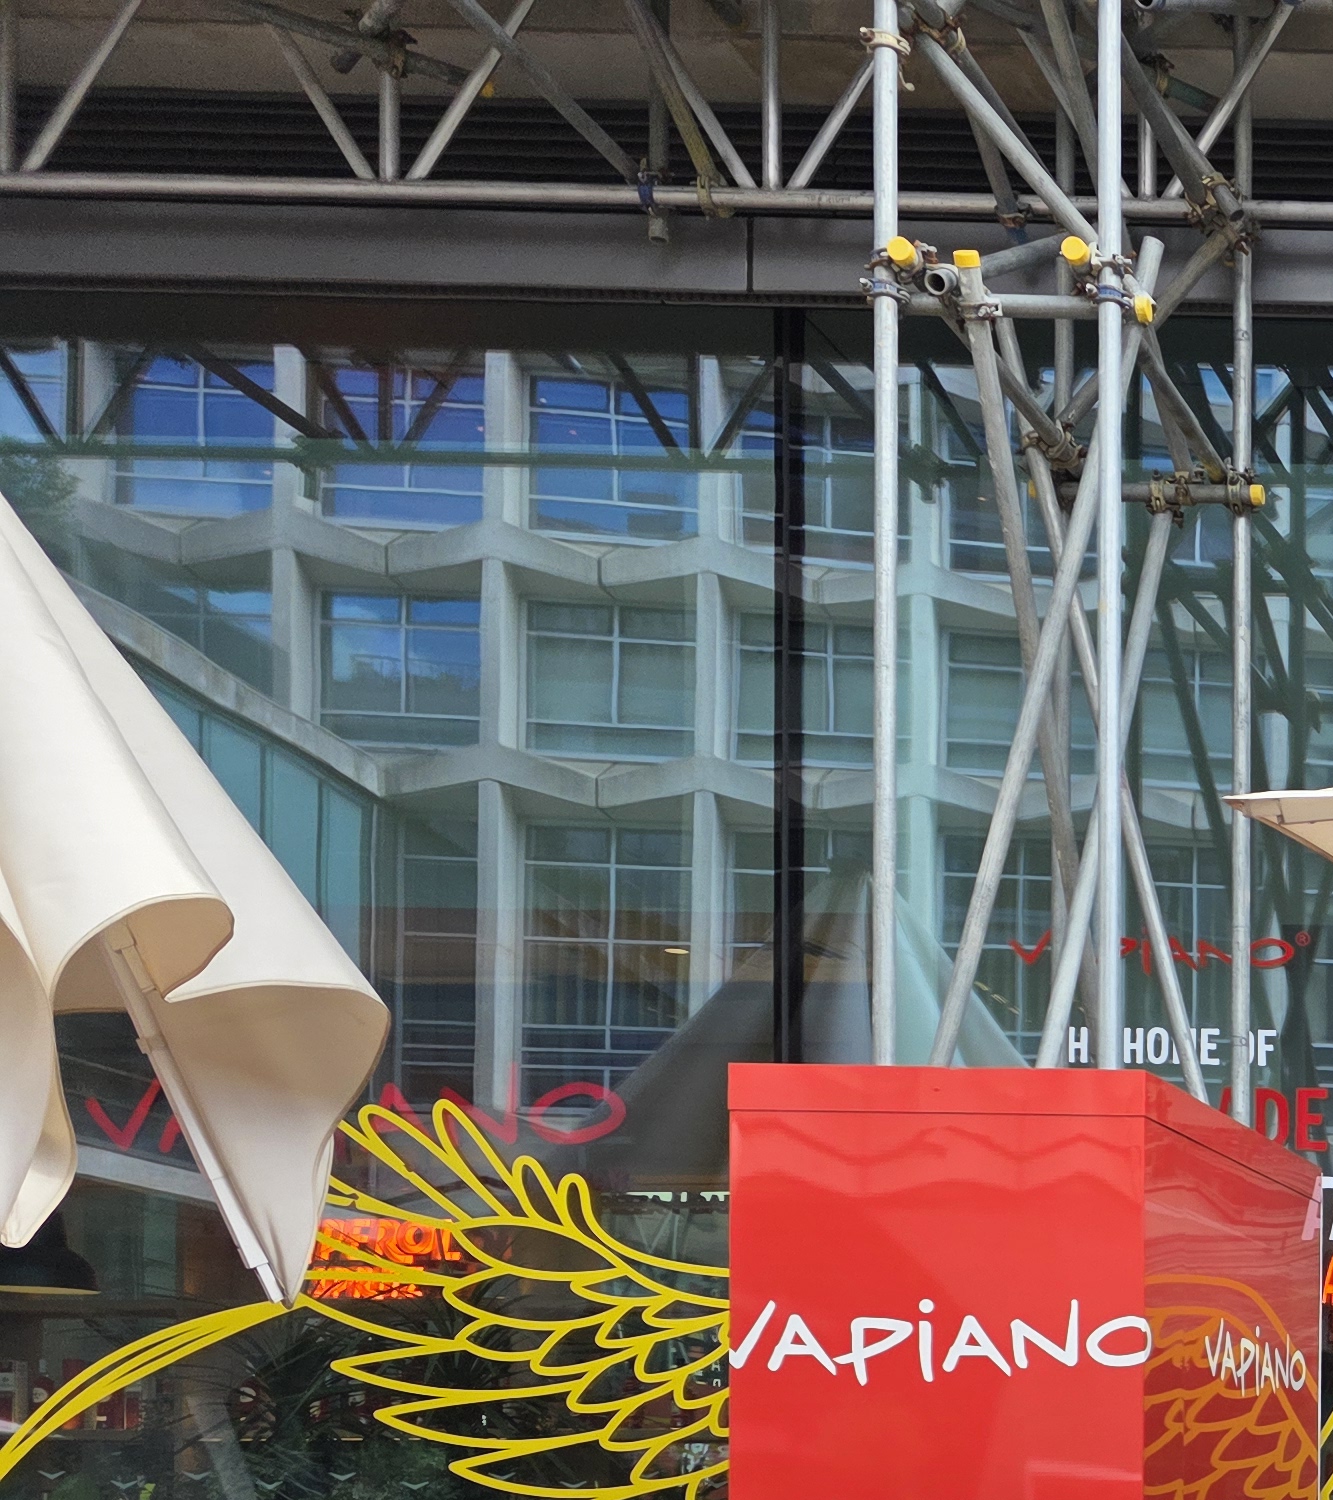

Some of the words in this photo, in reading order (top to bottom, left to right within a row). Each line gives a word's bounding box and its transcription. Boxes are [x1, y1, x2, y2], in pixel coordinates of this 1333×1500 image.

[312, 1218, 462, 1265] PEROL
[728, 1298, 1152, 1386] VAPiANO
[1204, 1317, 1307, 1398] VAPiANO
